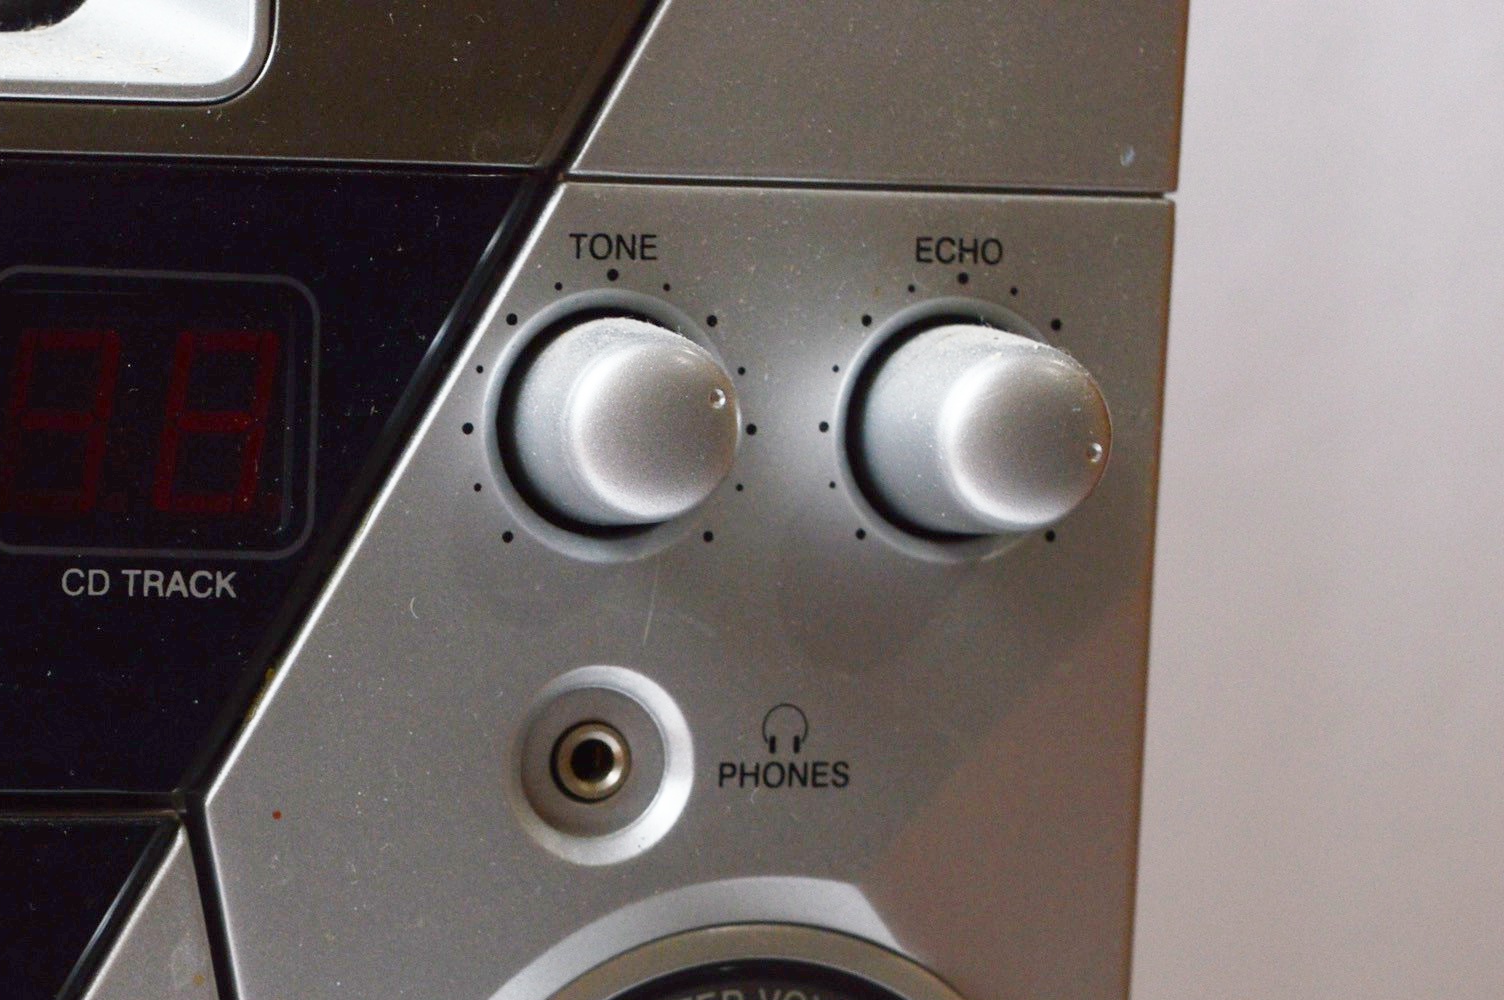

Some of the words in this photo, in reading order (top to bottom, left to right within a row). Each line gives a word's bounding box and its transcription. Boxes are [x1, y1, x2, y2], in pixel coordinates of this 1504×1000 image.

[570, 233, 657, 260] TONE
[916, 237, 1003, 265] ECHO
[62, 568, 109, 596] CD
[122, 570, 236, 598] TRACK
[719, 761, 849, 788] PHONES
